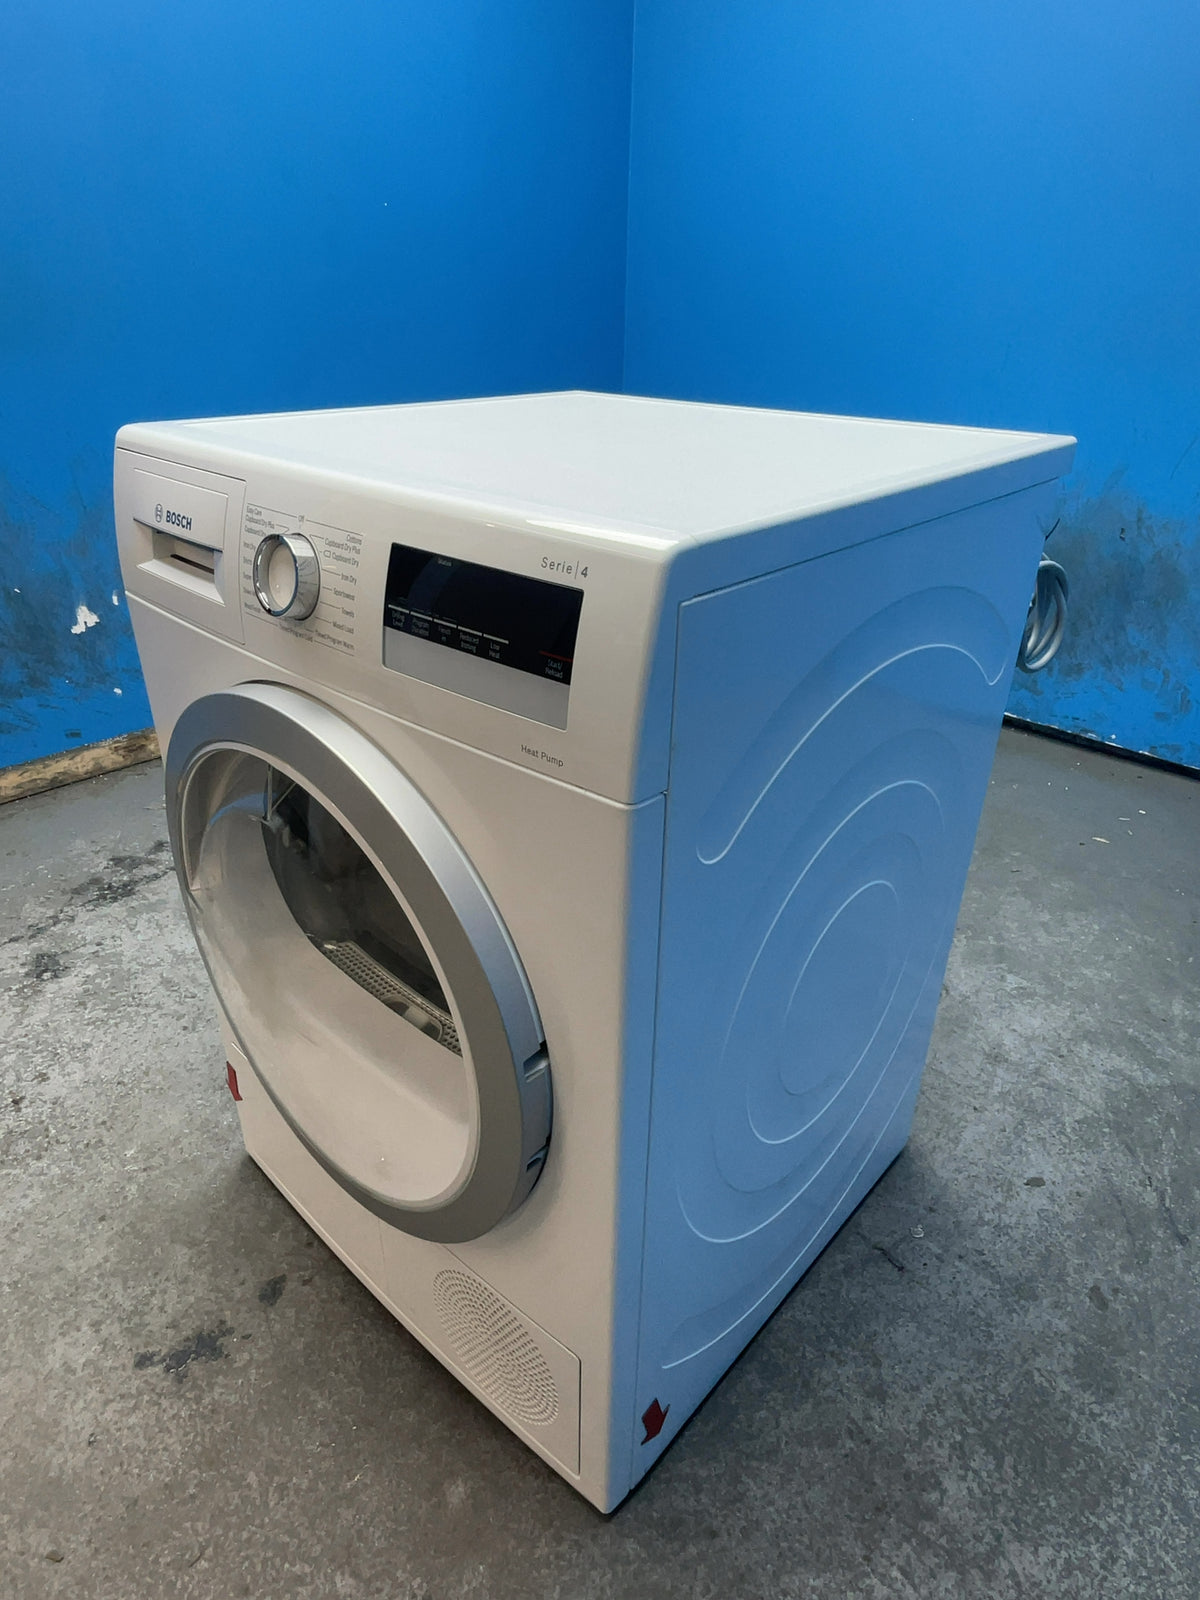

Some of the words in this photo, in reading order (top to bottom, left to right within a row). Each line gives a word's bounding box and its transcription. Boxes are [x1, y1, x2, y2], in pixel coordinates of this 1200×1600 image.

[165, 509, 192, 531] BOSCH
[540, 556, 573, 575] Serie
[580, 566, 589, 578] 4
[520, 744, 539, 759] Heat
[540, 751, 564, 768] Pump
